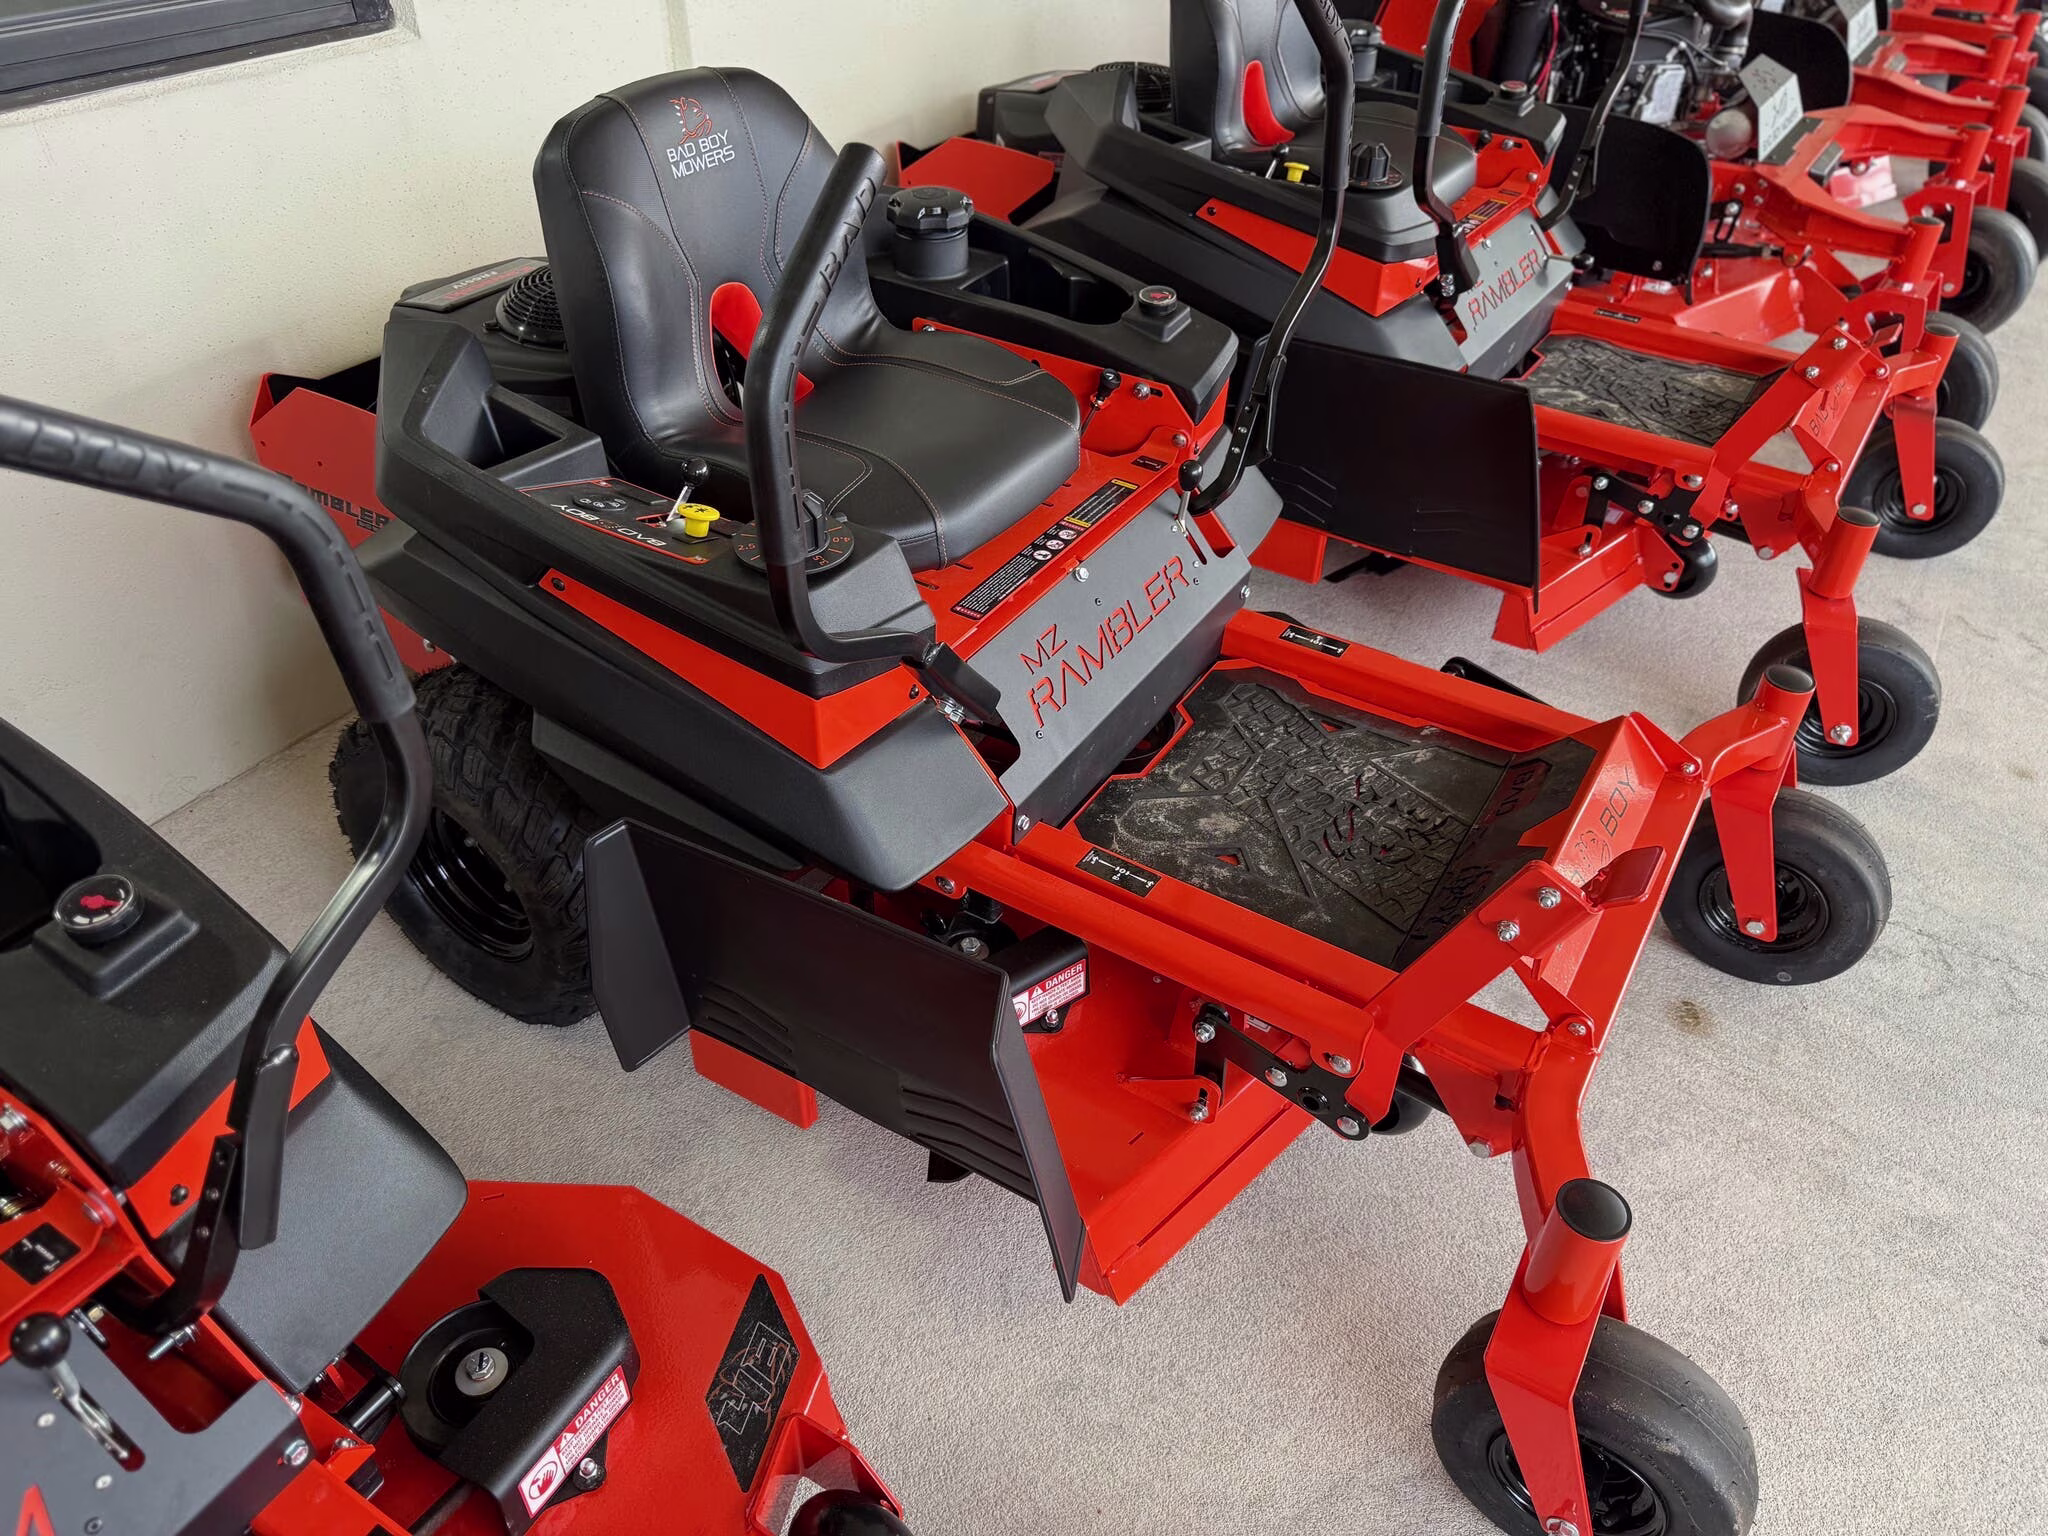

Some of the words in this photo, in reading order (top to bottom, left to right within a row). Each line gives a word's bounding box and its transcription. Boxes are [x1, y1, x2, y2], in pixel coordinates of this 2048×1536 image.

[666, 143, 696, 163] BAD
[699, 129, 728, 152] BOY
[671, 145, 735, 179] MOWERS
[1467, 248, 1543, 326] RAMBLER
[551, 503, 600, 521] BOY
[617, 527, 667, 546] BAD
[1019, 623, 1068, 675] MZ
[1026, 555, 1190, 728] RAMBLER
[1600, 766, 1635, 836] BOY
[1045, 963, 1083, 990] DANGER
[574, 1373, 619, 1430] DANGER
